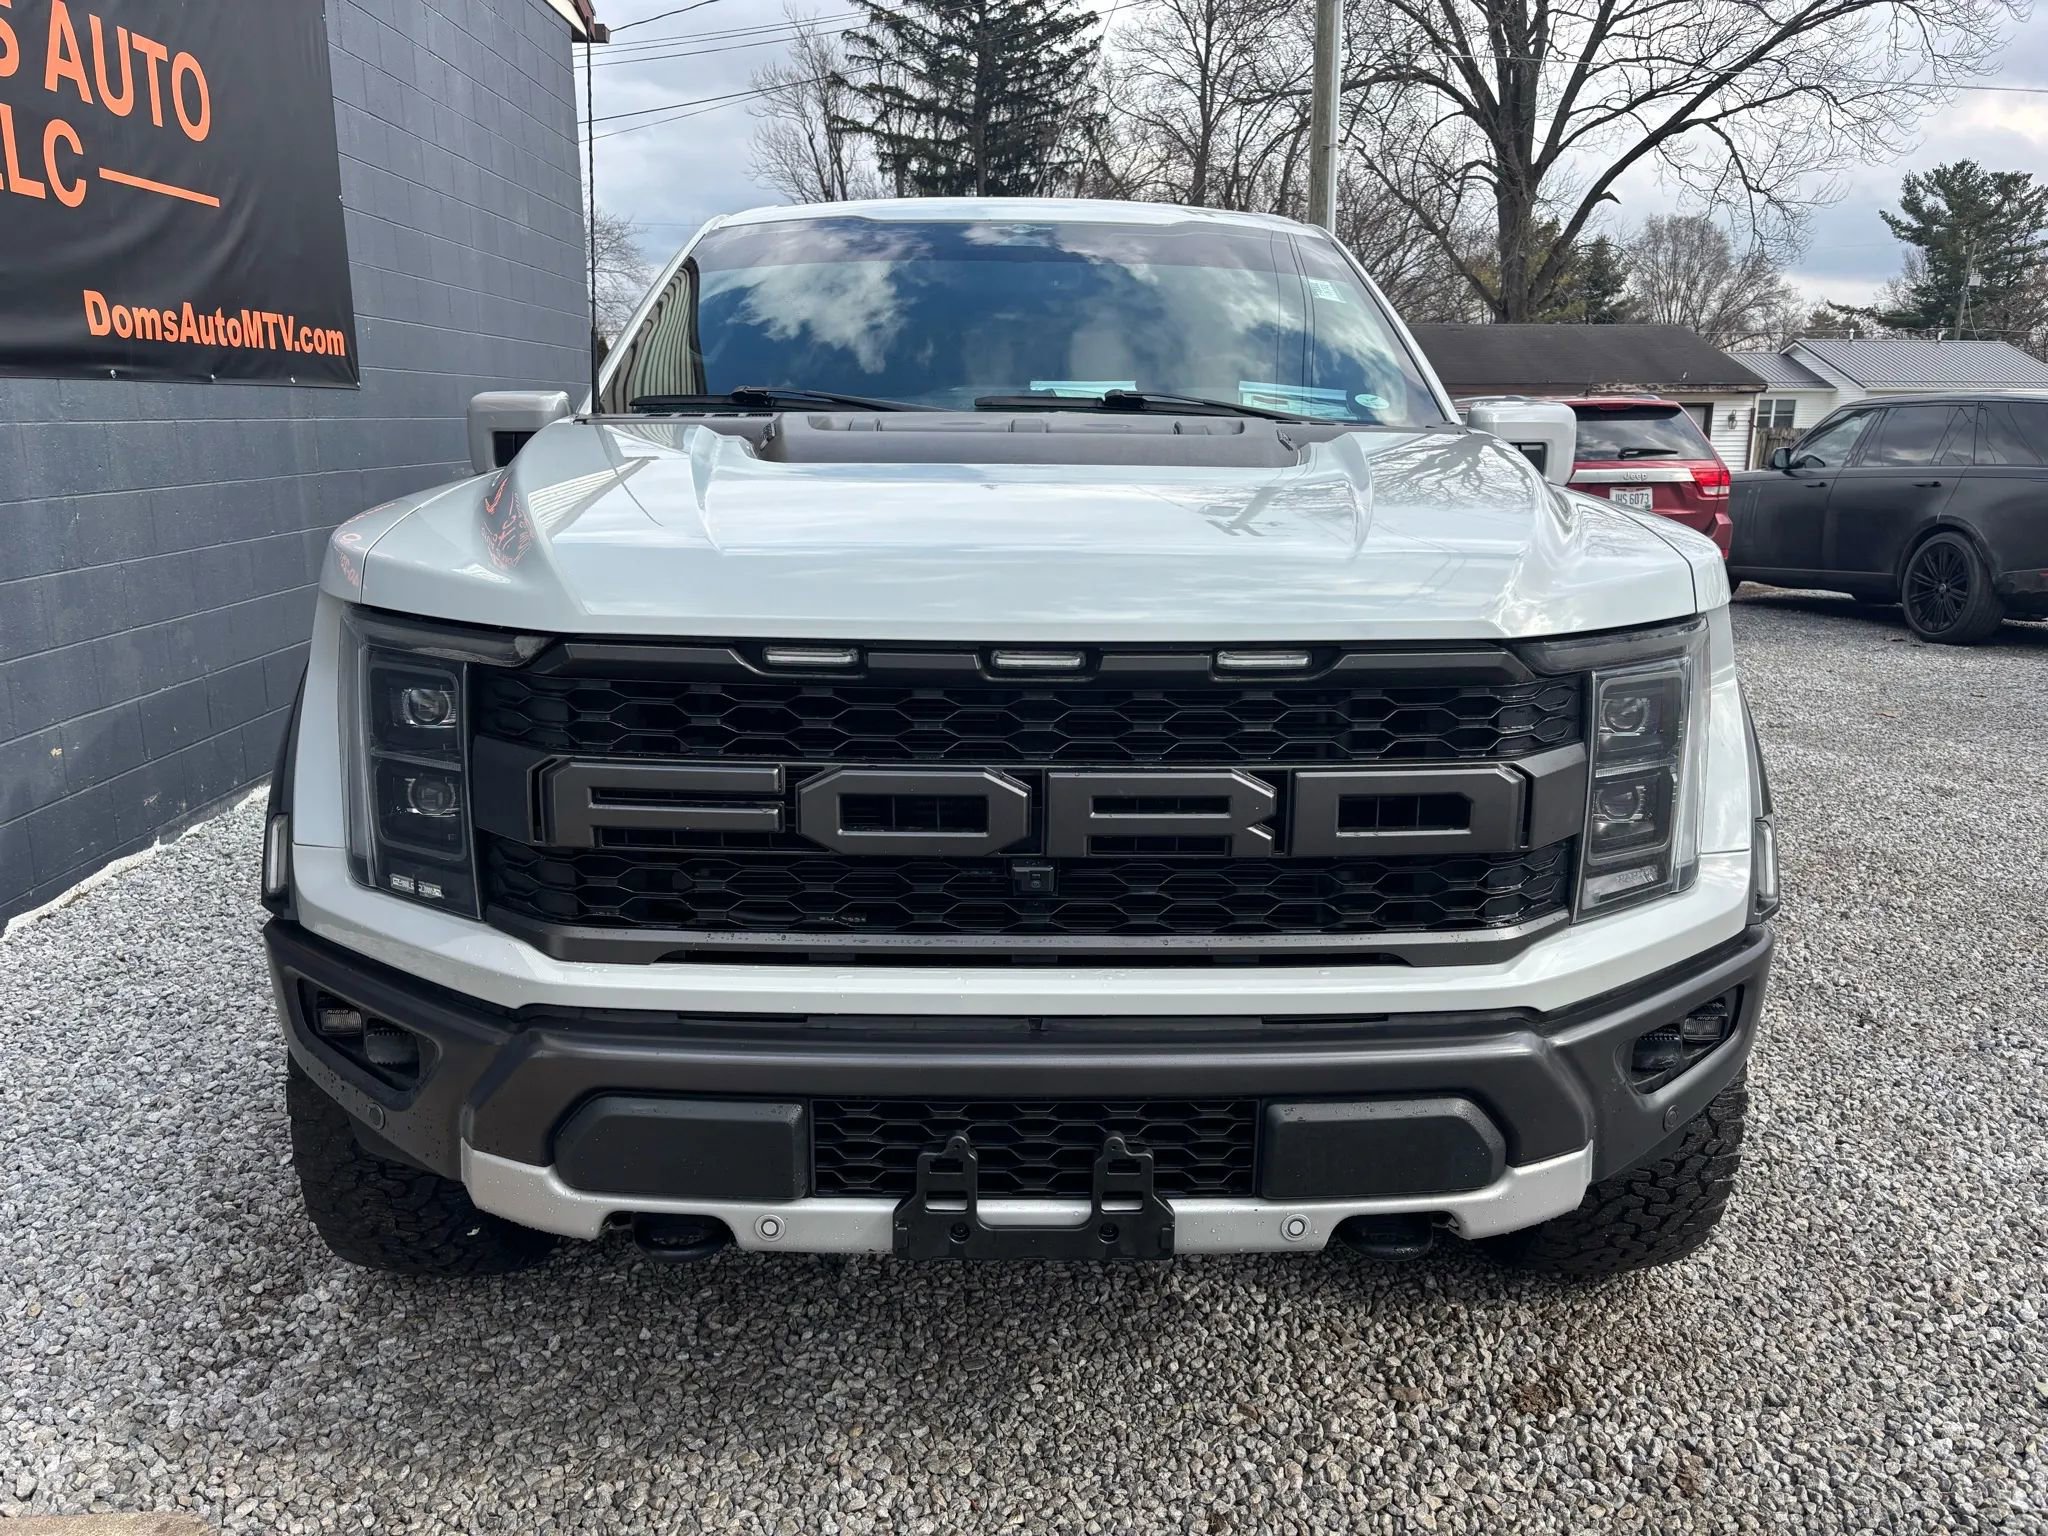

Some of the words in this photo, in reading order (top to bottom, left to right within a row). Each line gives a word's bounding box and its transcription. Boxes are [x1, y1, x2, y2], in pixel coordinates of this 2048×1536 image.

[44, 0, 211, 142] AUTO
[0, 103, 87, 208] LC
[83, 289, 346, 357] DomsAutoMTV.com
[1623, 471, 1648, 482] Jeep
[1629, 493, 1649, 505] 6073
[541, 758, 1526, 860] FORD
